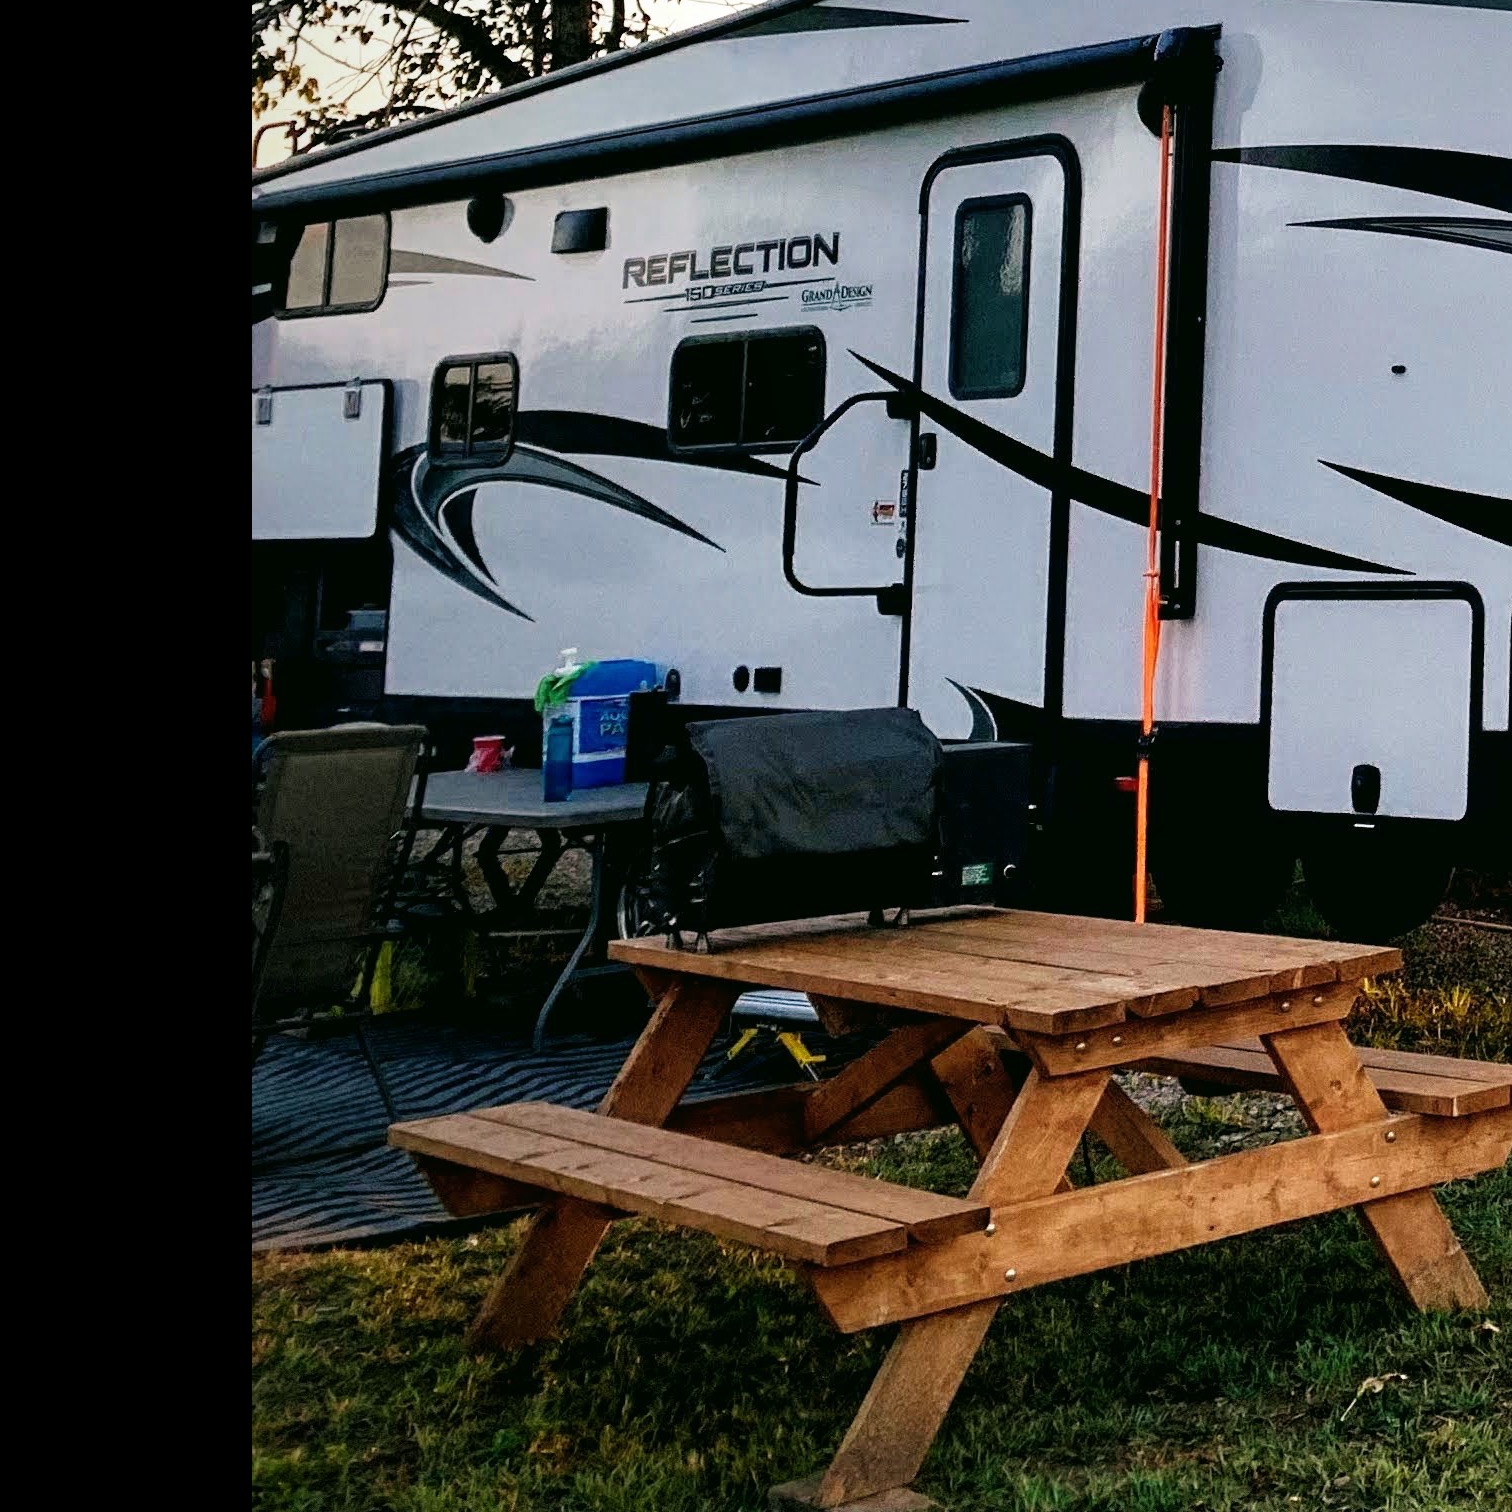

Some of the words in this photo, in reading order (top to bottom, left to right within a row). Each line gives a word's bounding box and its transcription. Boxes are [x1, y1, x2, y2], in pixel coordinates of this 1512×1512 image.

[622, 232, 840, 289] REFLECTION
[685, 285, 714, 302] 150
[714, 281, 765, 297] SERIES
[801, 289, 833, 303] GRAND
[841, 284, 873, 299] DESIGN
